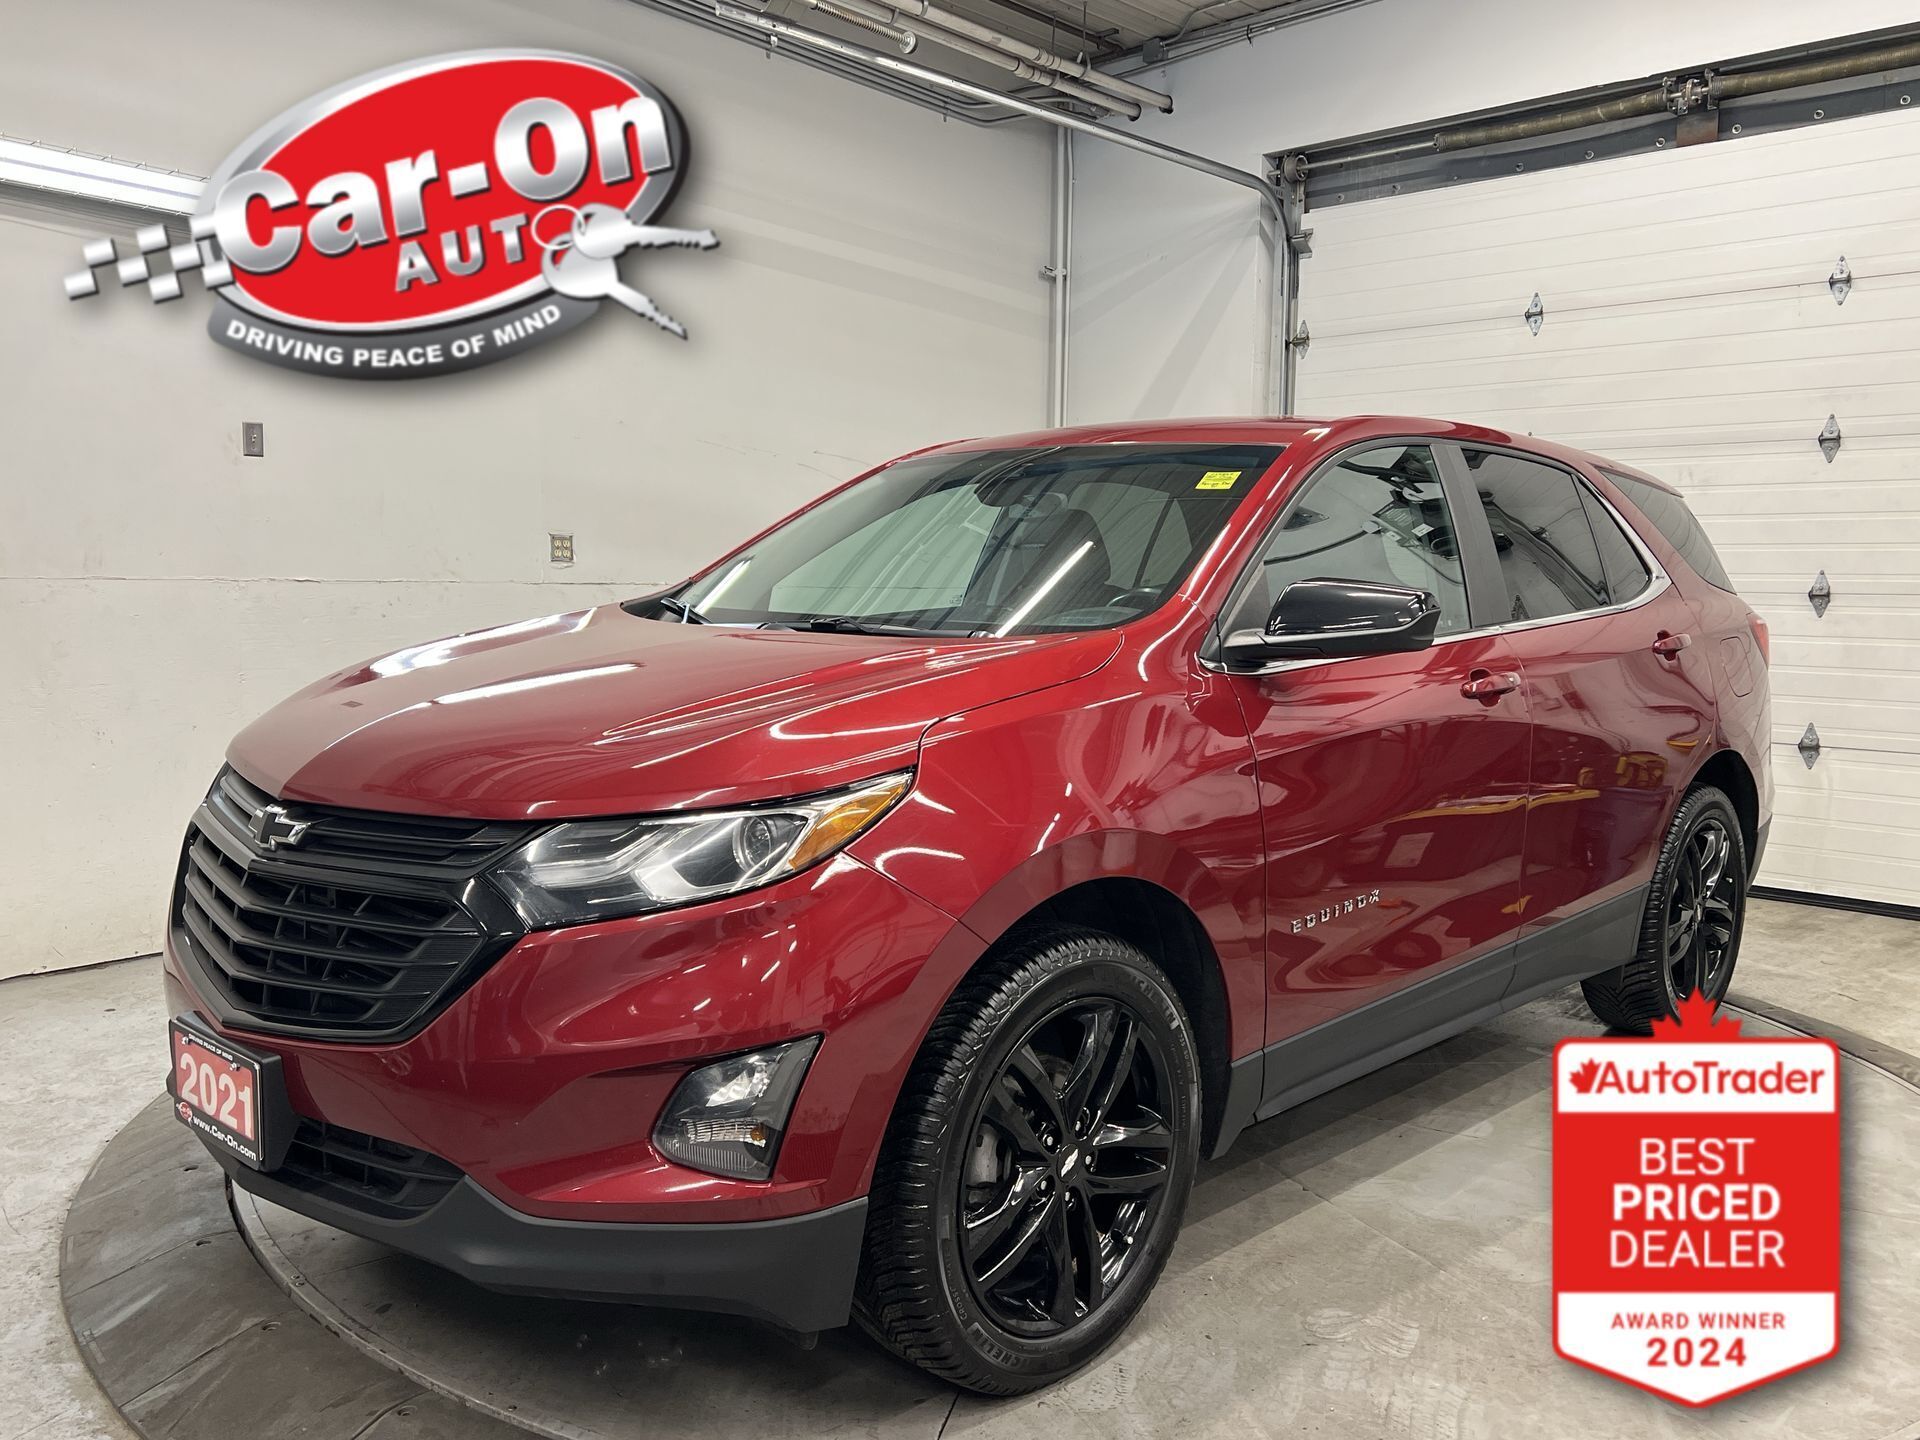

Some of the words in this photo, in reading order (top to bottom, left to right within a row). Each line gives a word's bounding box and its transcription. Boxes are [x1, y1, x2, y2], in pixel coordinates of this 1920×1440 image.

[1291, 888, 1380, 934] EQUINOX
[180, 1052, 252, 1139] 2021
[193, 1115, 257, 1162] www.Car-On.com
